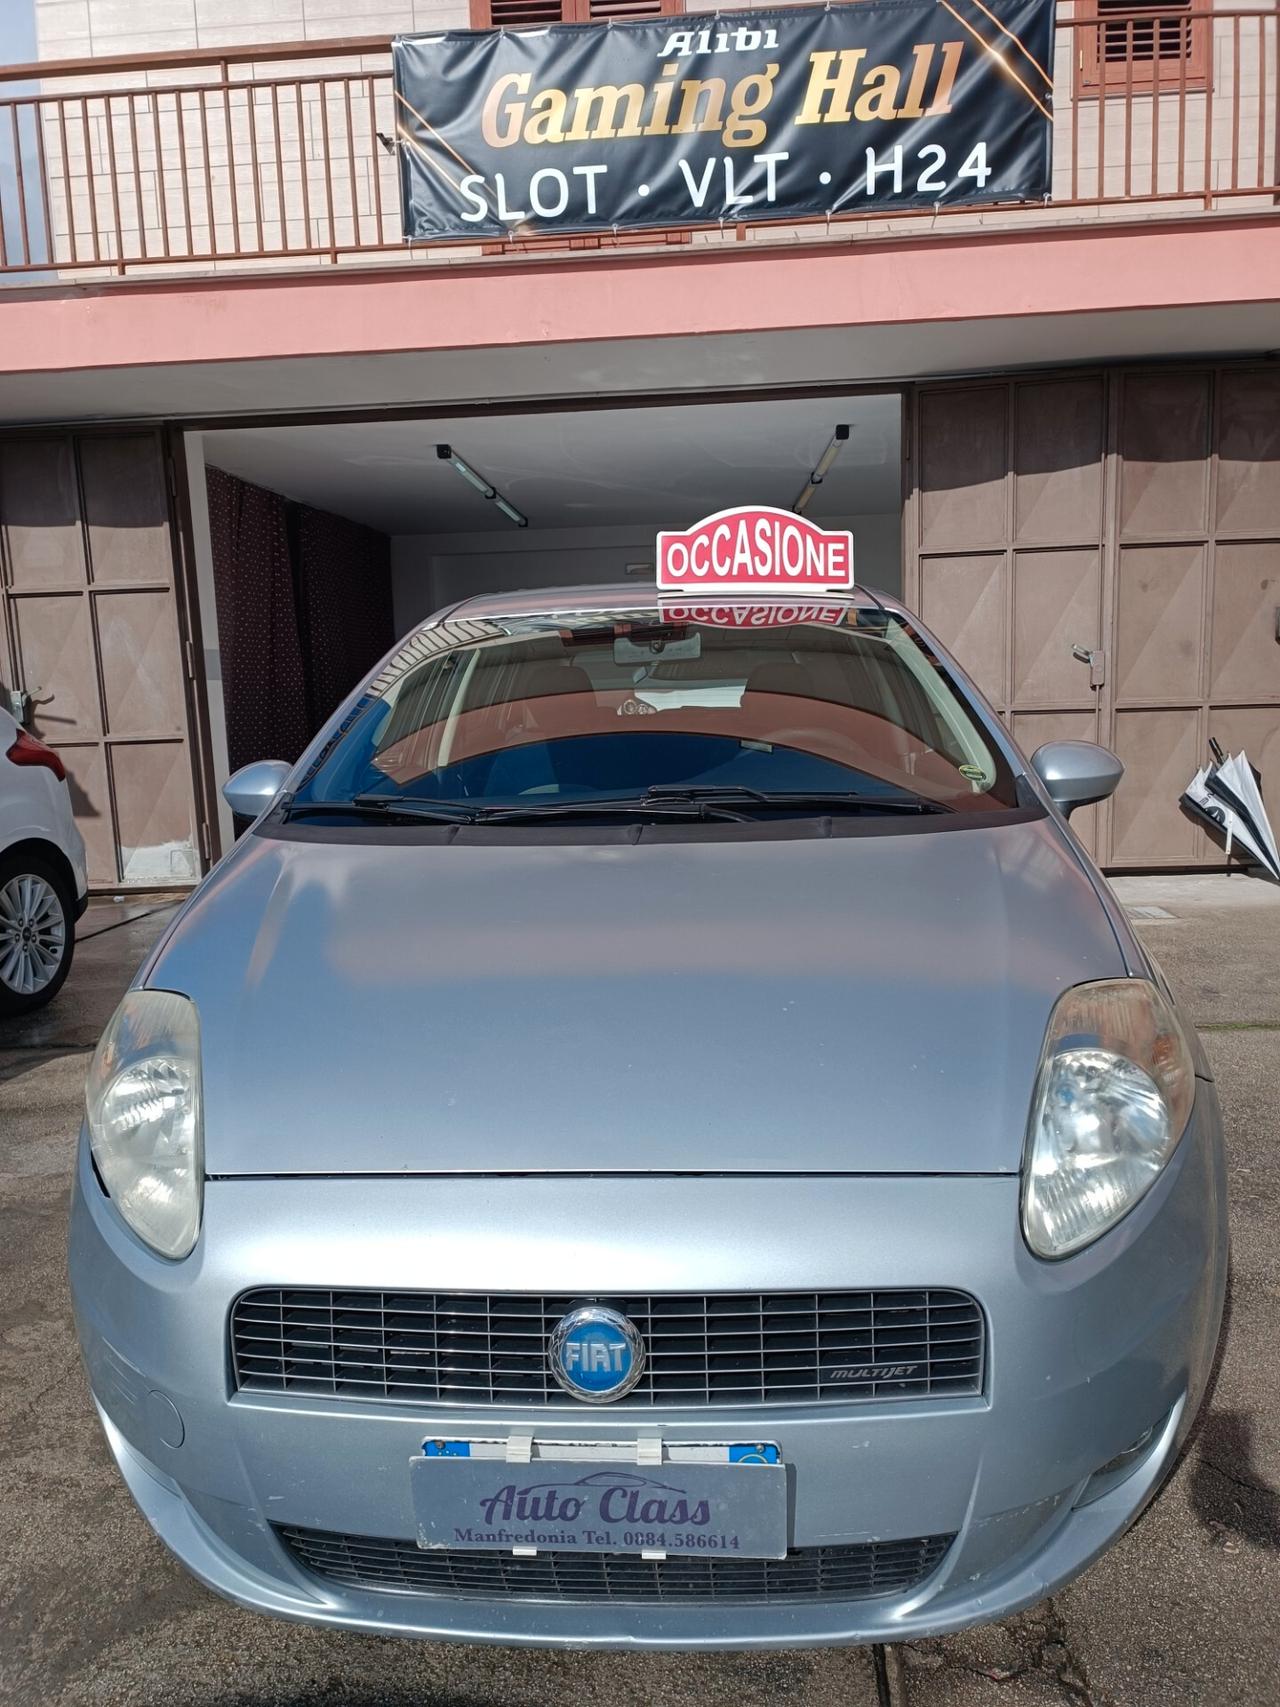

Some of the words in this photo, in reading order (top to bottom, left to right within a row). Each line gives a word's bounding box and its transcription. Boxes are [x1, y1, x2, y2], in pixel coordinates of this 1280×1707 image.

[482, 64, 780, 148] Gaming
[796, 41, 964, 125] Hall
[460, 164, 608, 222] SLOT
[678, 151, 790, 208] VLT
[866, 142, 992, 195] H24
[667, 518, 846, 576] OCCASIONE
[566, 1342, 627, 1372] FIAT
[480, 1484, 586, 1526] Auto
[599, 1487, 711, 1526] Class
[454, 1528, 577, 1545] Manfredonia
[582, 1531, 618, 1546] Tel.
[623, 1532, 740, 1550] 0884.586614
